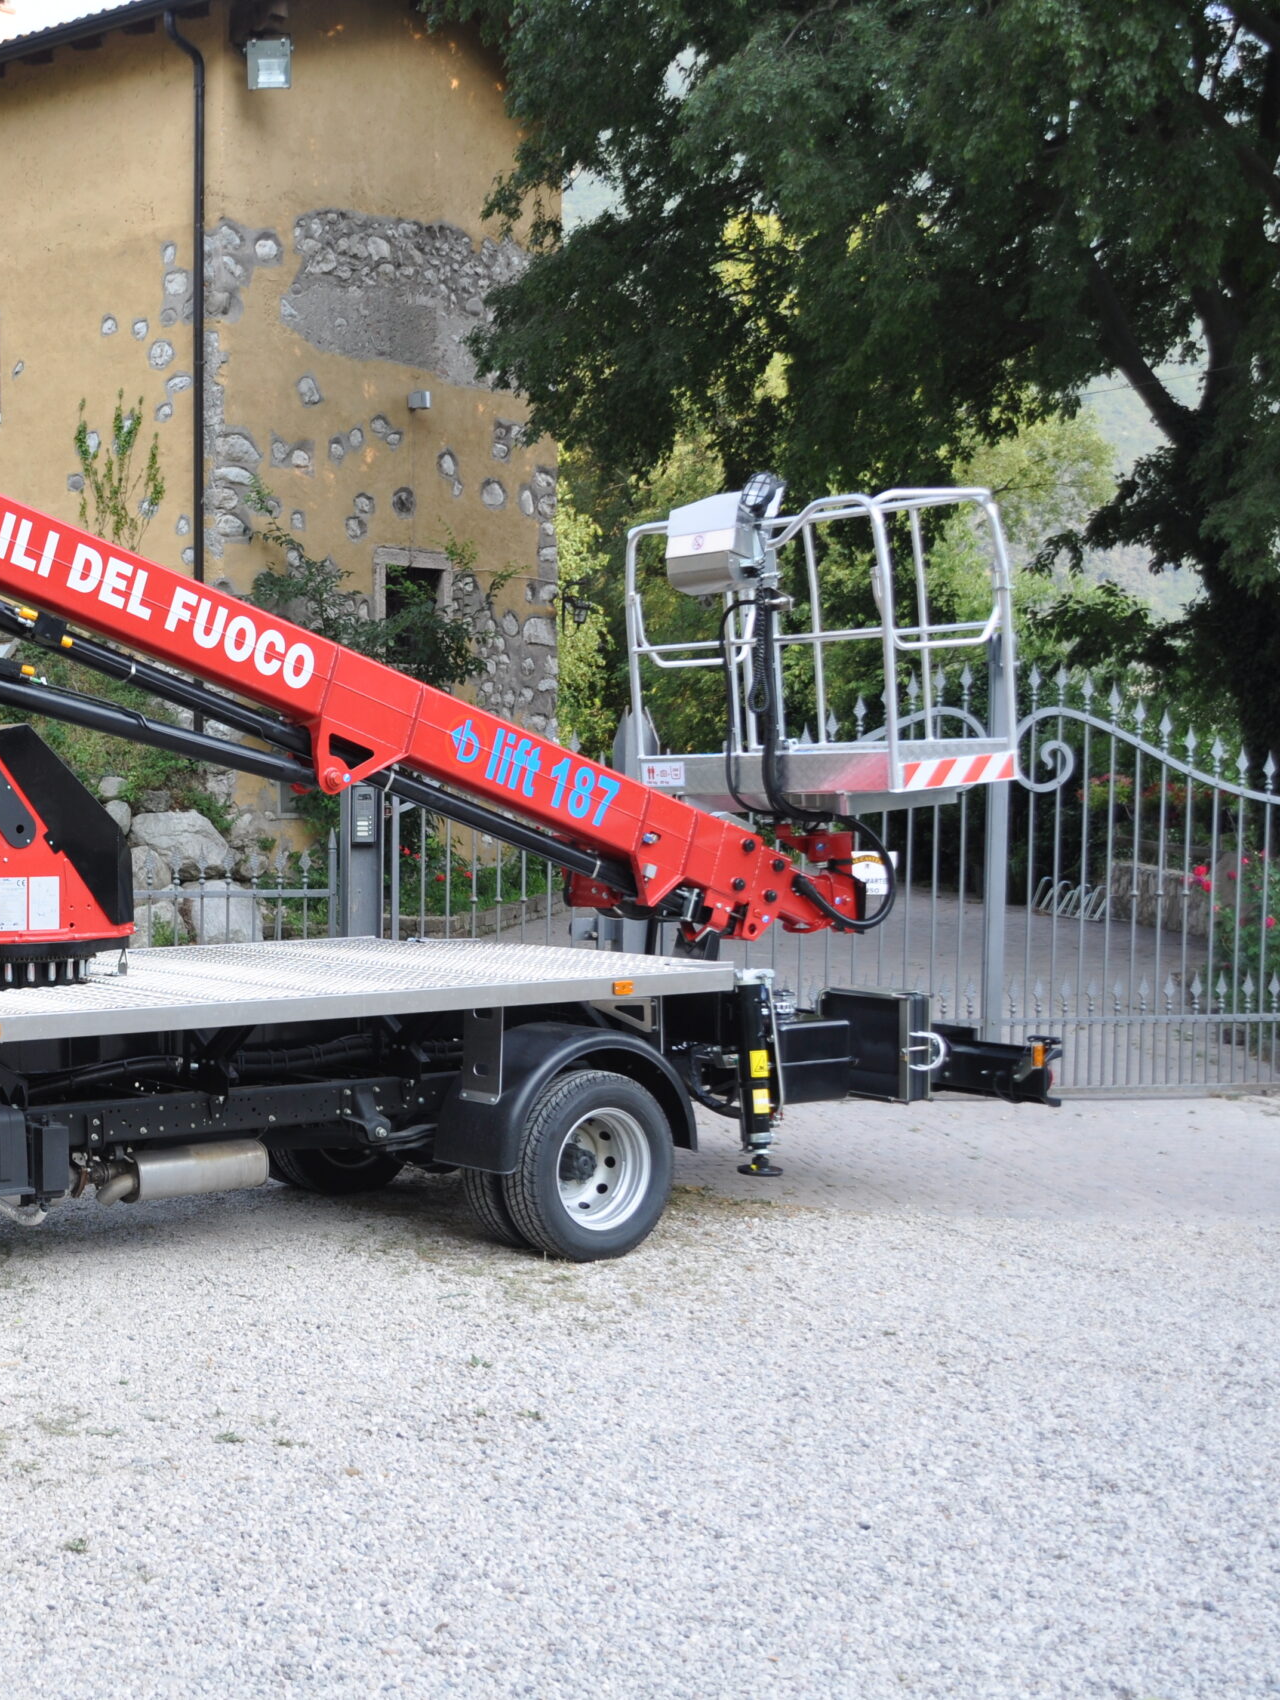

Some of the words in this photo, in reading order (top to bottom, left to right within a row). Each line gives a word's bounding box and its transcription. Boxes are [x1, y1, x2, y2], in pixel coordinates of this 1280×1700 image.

[66, 542, 152, 621] DEL
[164, 586, 315, 689] FUOCO
[485, 728, 542, 798] lift
[550, 757, 621, 827] 187
